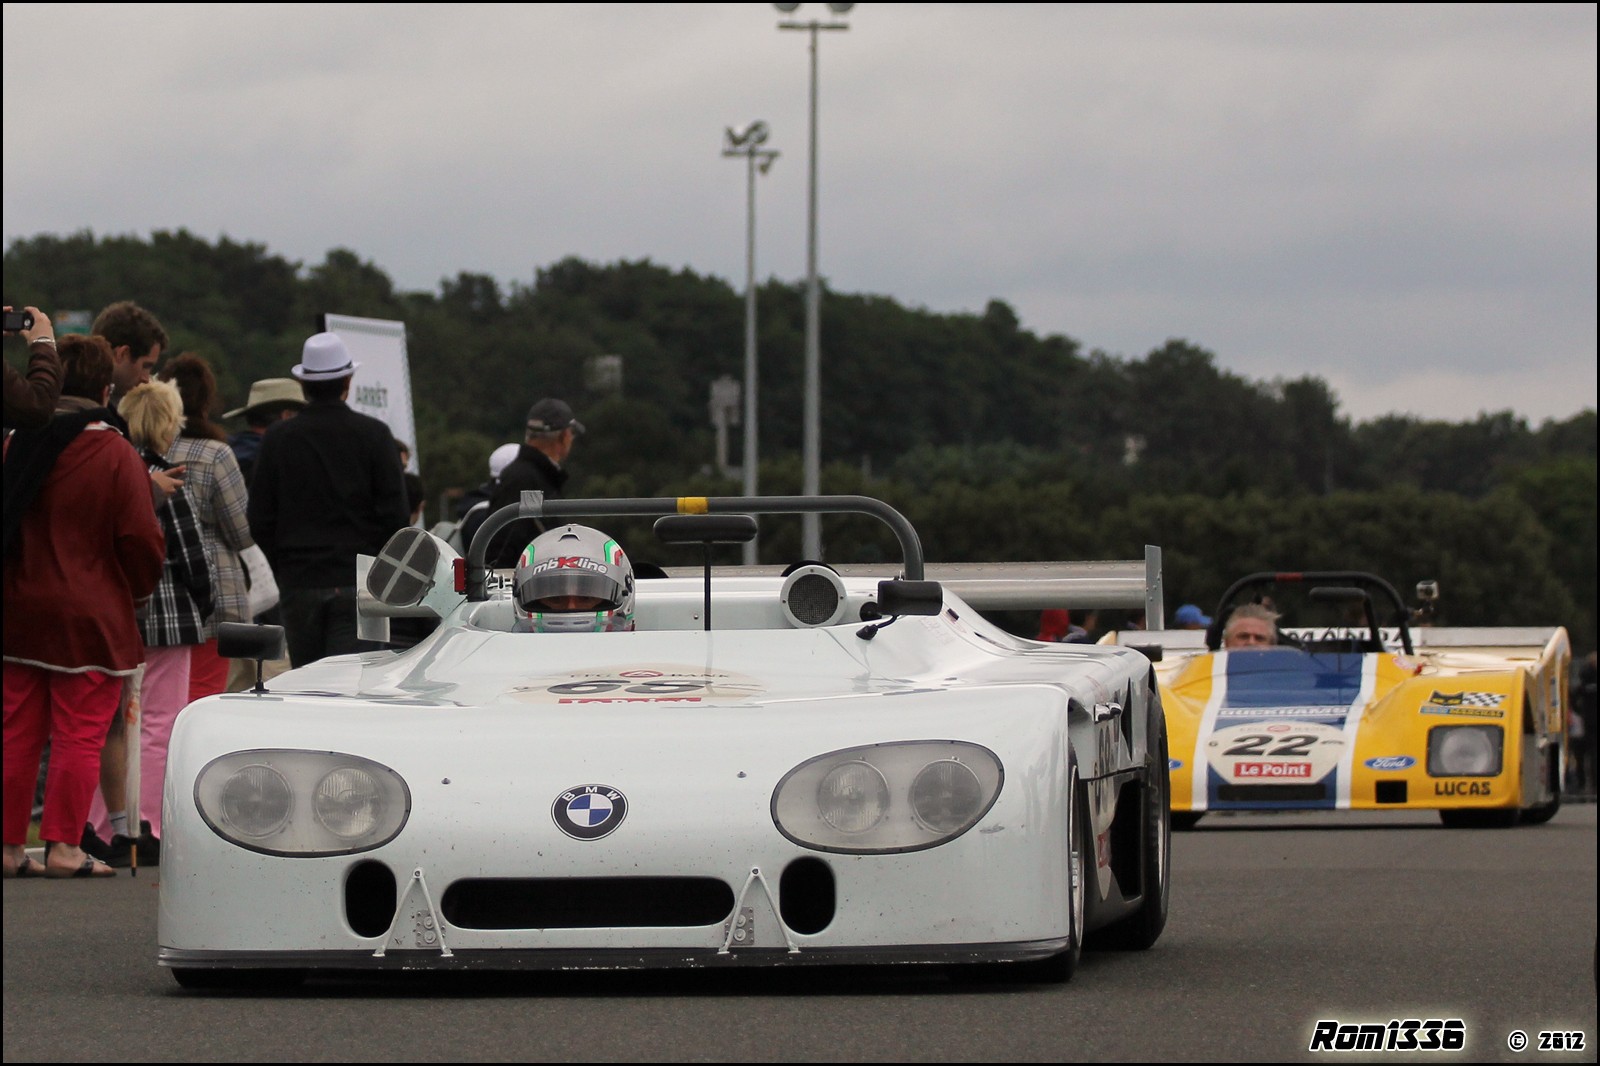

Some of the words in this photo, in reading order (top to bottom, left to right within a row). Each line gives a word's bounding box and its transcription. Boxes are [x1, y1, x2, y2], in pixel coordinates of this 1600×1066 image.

[1222, 734, 1319, 756] 22
[1241, 763, 1259, 775] Le
[1262, 763, 1307, 775] Point
[1373, 757, 1406, 767] Ford
[561, 786, 621, 802] BMW
[1435, 781, 1491, 796] LUCAS
